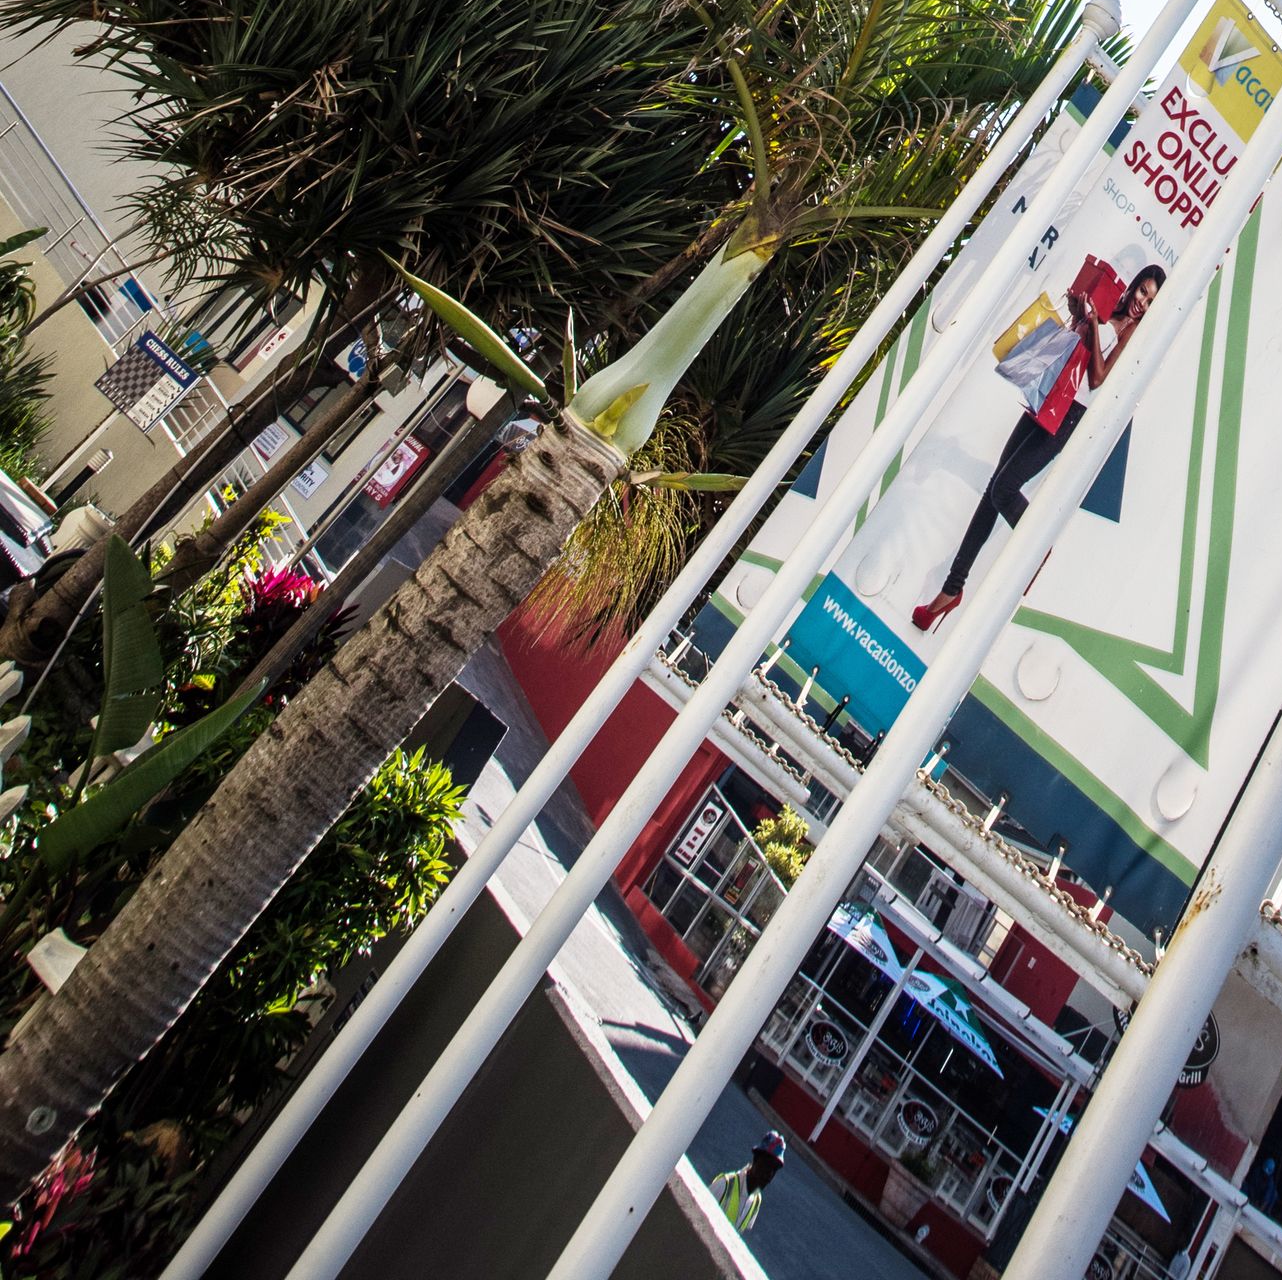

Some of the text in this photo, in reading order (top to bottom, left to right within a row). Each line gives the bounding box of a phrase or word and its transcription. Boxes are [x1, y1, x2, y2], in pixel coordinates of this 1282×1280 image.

[1160, 86, 1238, 177] EXCLU
[1103, 177, 1135, 216] SHOP
[1124, 140, 1204, 230] SHOPP
[1157, 131, 1222, 210] ONLI
[146, 339, 191, 381] CHESS RULES
[1178, 1070, 1202, 1086] Grill
